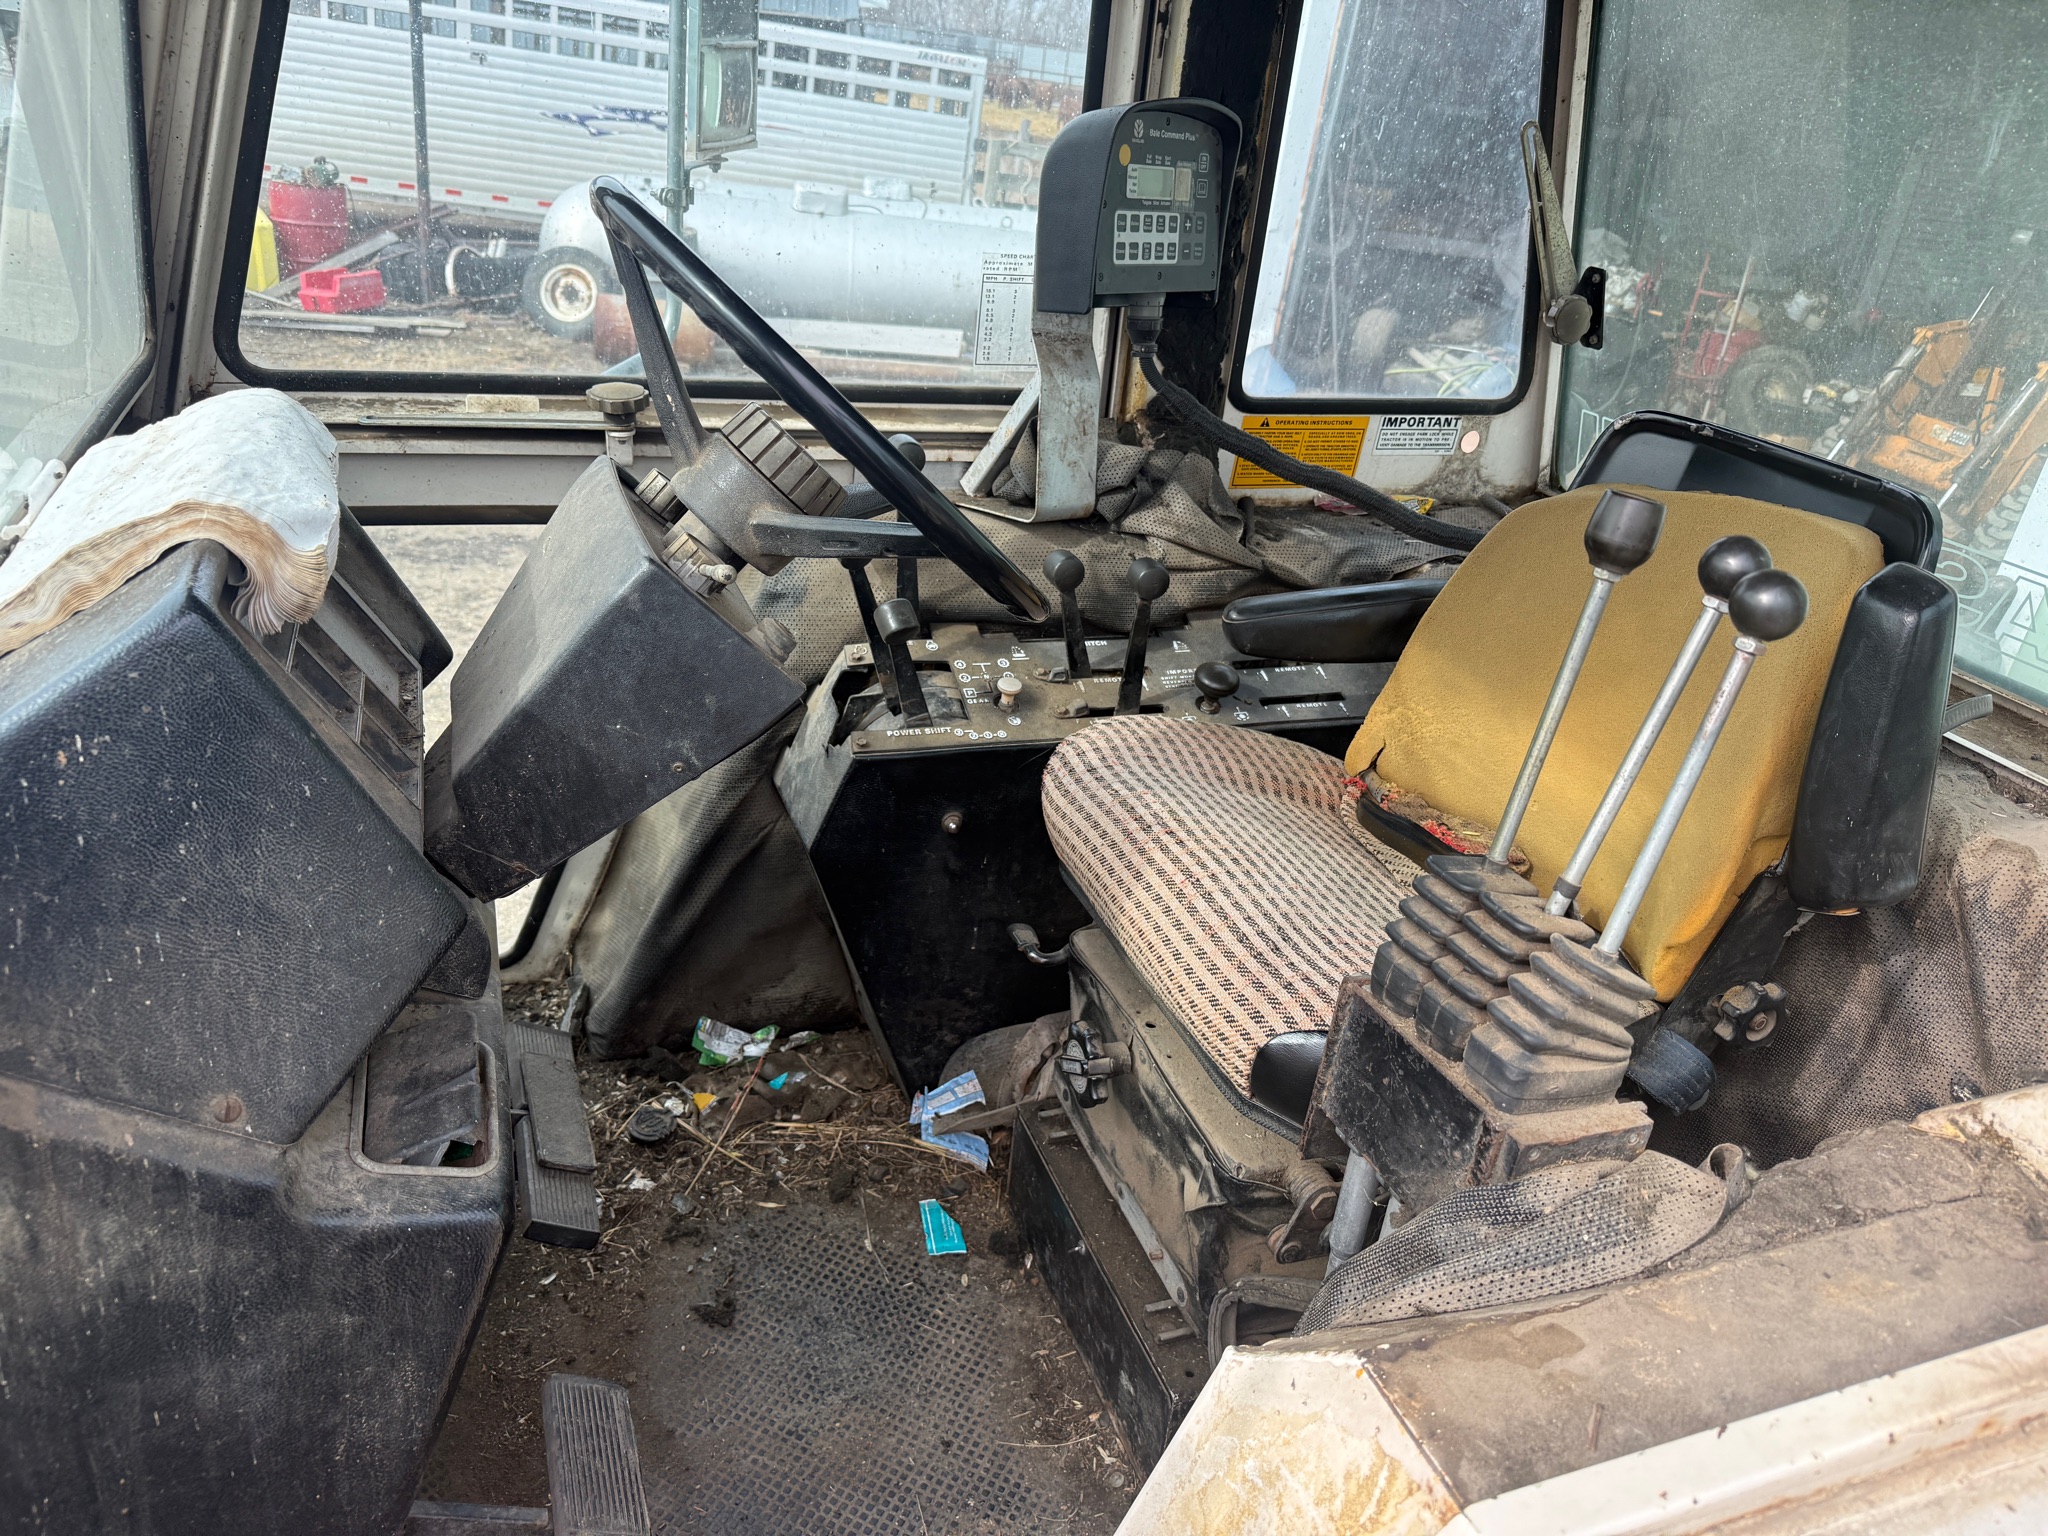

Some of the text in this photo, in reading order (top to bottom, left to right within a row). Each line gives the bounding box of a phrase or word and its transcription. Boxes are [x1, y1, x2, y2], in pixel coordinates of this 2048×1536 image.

[1150, 128, 1160, 138] Bale
[1161, 130, 1184, 140] Command
[1382, 416, 1462, 428] IMPORTANT
[887, 729, 921, 737] POWER
